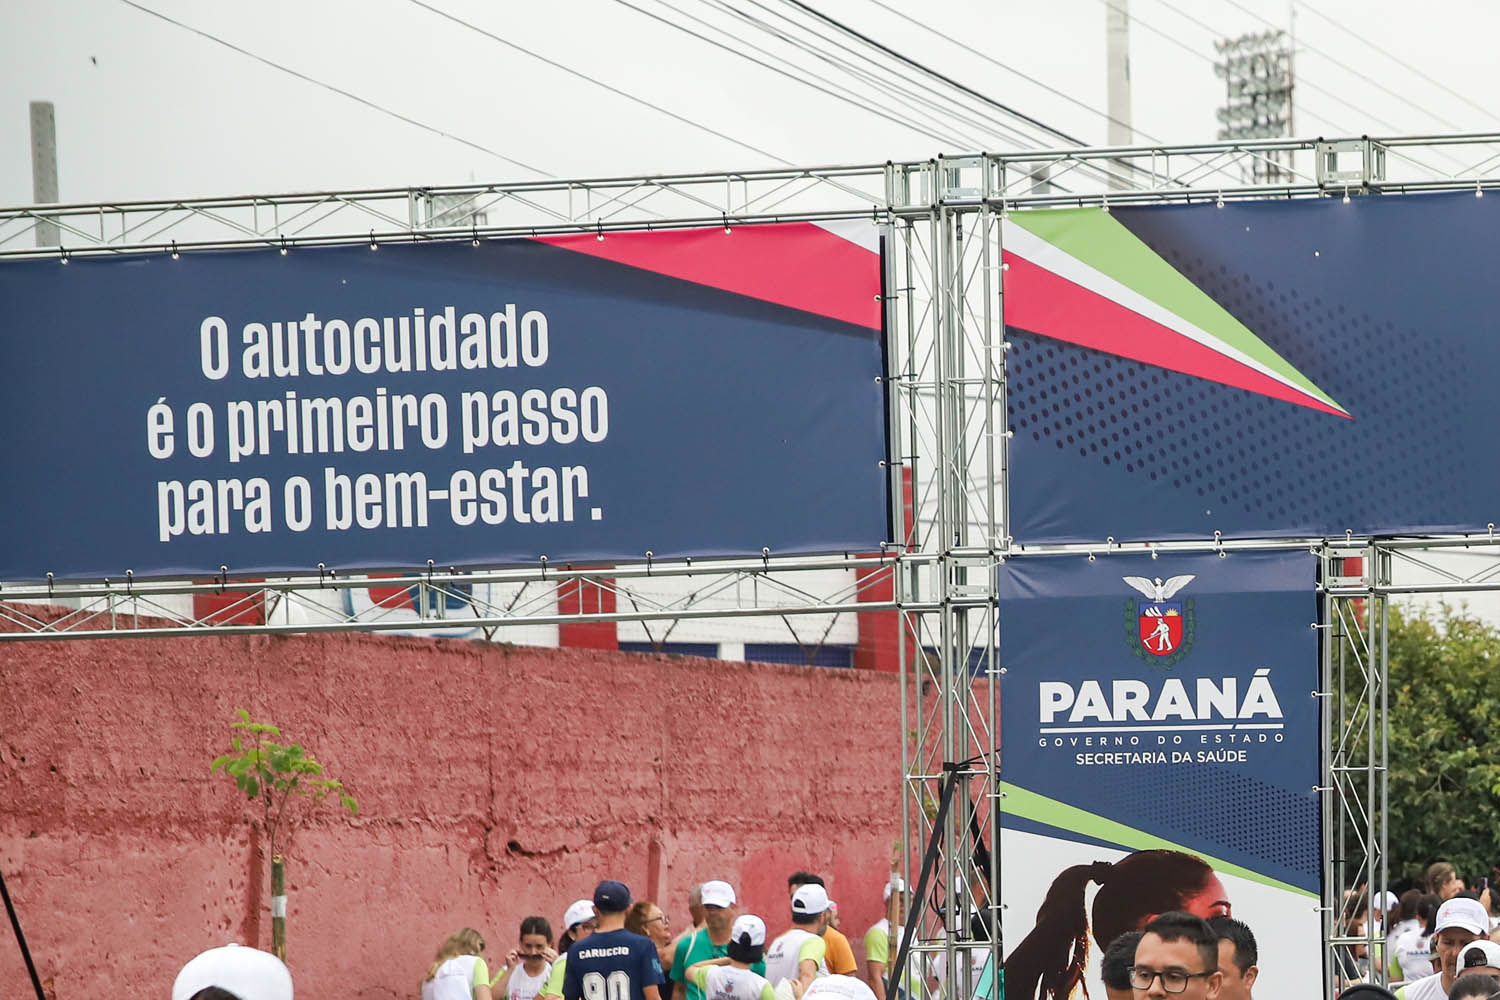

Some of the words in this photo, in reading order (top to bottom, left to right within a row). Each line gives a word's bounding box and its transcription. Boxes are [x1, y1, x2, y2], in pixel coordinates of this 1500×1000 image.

[201, 316, 229, 380] O
[243, 303, 549, 377] autocuidado
[147, 397, 174, 459] é
[188, 402, 214, 456] o
[228, 393, 449, 462] primeiro
[461, 387, 608, 453] passo
[159, 475, 271, 541] para
[285, 476, 312, 531] o
[325, 461, 602, 530] bem-estar.
[1039, 668, 1284, 723] PARANÁ
[1039, 735, 1140, 748] GOVERNO
[1158, 735, 1182, 745] DO
[1201, 732, 1284, 744] ESTADO
[1076, 752, 1167, 765] SECRETARIA
[1172, 751, 1192, 763] DA
[1197, 748, 1247, 763] SAÚDE
[579, 946, 630, 960] CARUCCIO
